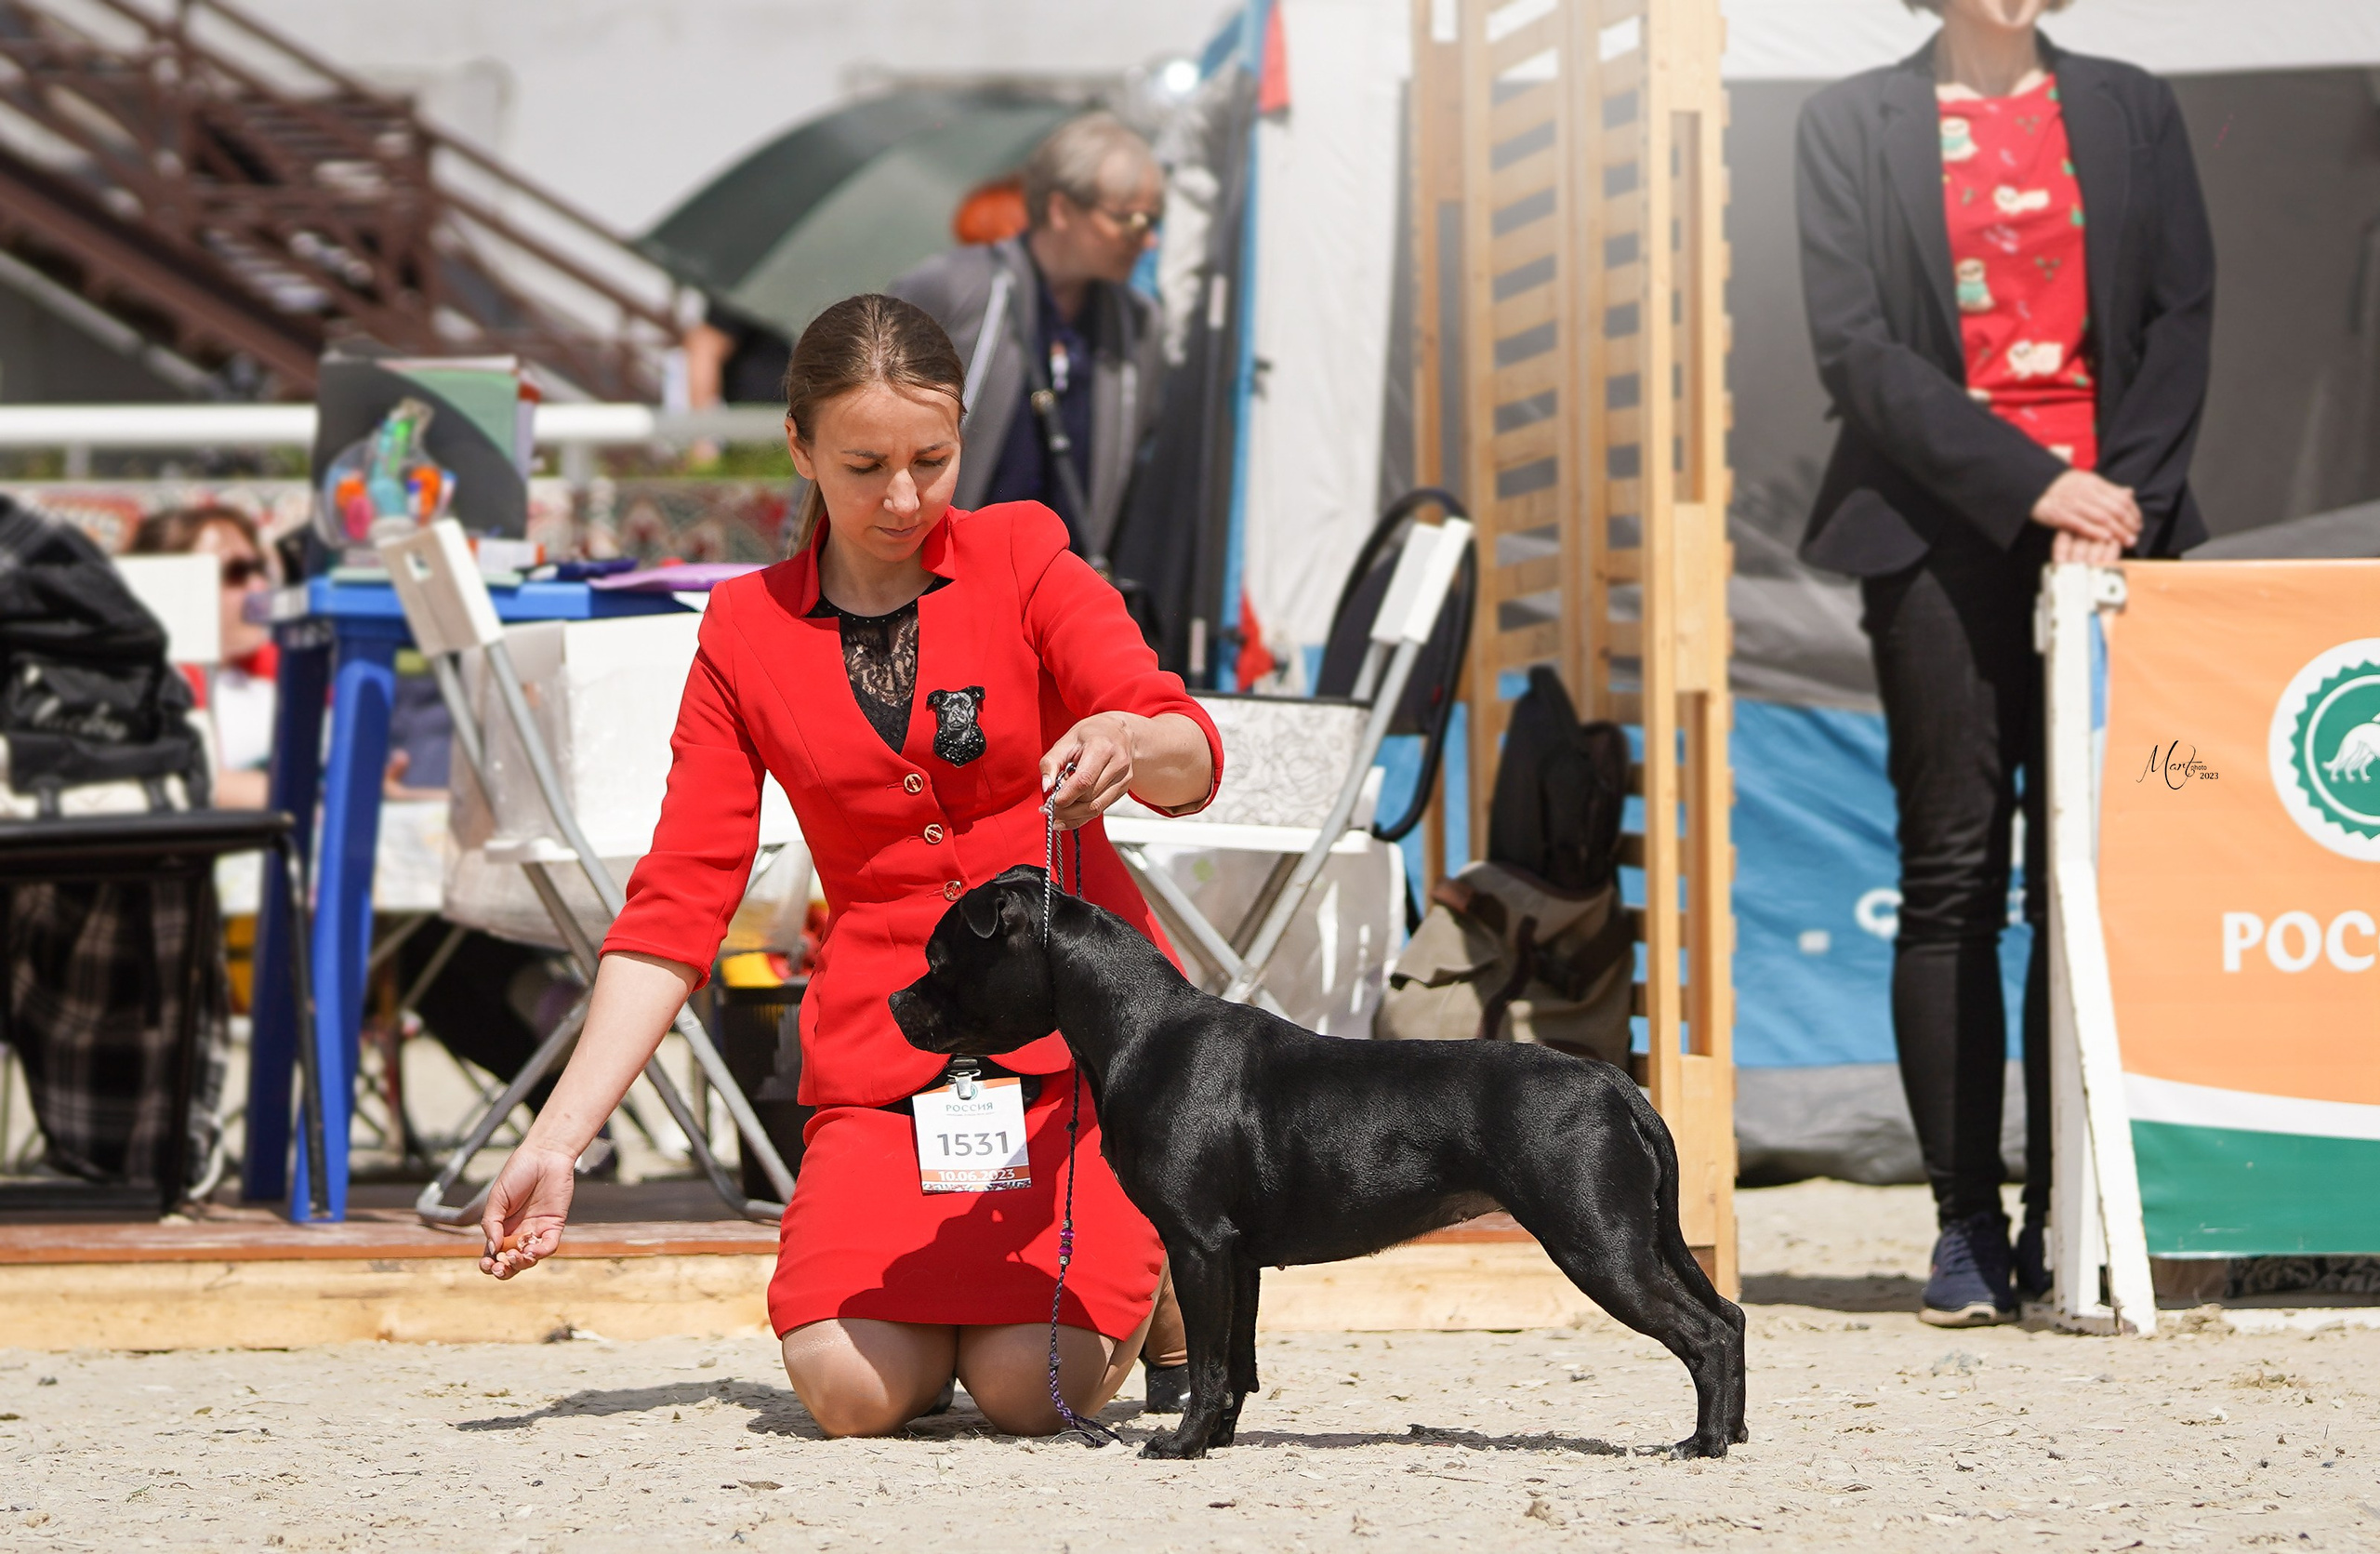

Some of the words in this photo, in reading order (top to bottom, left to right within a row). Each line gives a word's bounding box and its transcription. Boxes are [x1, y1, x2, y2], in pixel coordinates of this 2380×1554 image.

[2223, 910, 2380, 973] РОС
[945, 1102, 993, 1112] РОССИЯ
[937, 1131, 1009, 1156] 1531
[938, 1169, 1015, 1182] 10.06.2023
